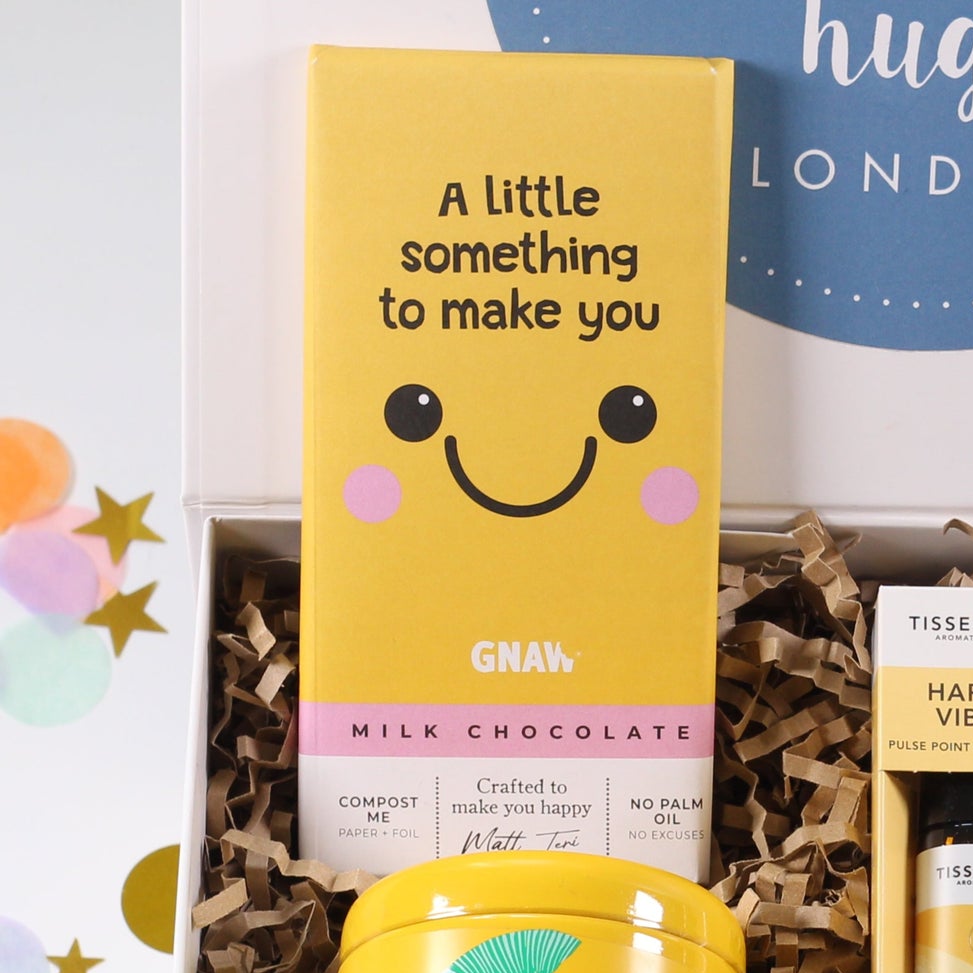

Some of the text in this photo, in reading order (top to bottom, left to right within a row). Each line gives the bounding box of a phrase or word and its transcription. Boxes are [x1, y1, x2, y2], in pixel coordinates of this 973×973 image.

[438, 175, 600, 218] A little
[401, 230, 638, 282] something
[378, 287, 660, 342] to make you
[471, 640, 575, 673] GNAW
[352, 723, 691, 740] MILK CHOCOLATE
[888, 740, 927, 751] PULSE
[931, 741, 971, 752] POINT
[477, 778, 567, 794] Crafted to
[339, 796, 419, 808] COMPOST
[452, 799, 592, 818] make you happy
[631, 798, 703, 810] NO PALM
[367, 811, 390, 823] ME
[654, 813, 681, 825] OIL
[339, 828, 378, 838] PAPER
[392, 828, 419, 838] FOIL
[629, 830, 704, 840] NO EXCUSES
